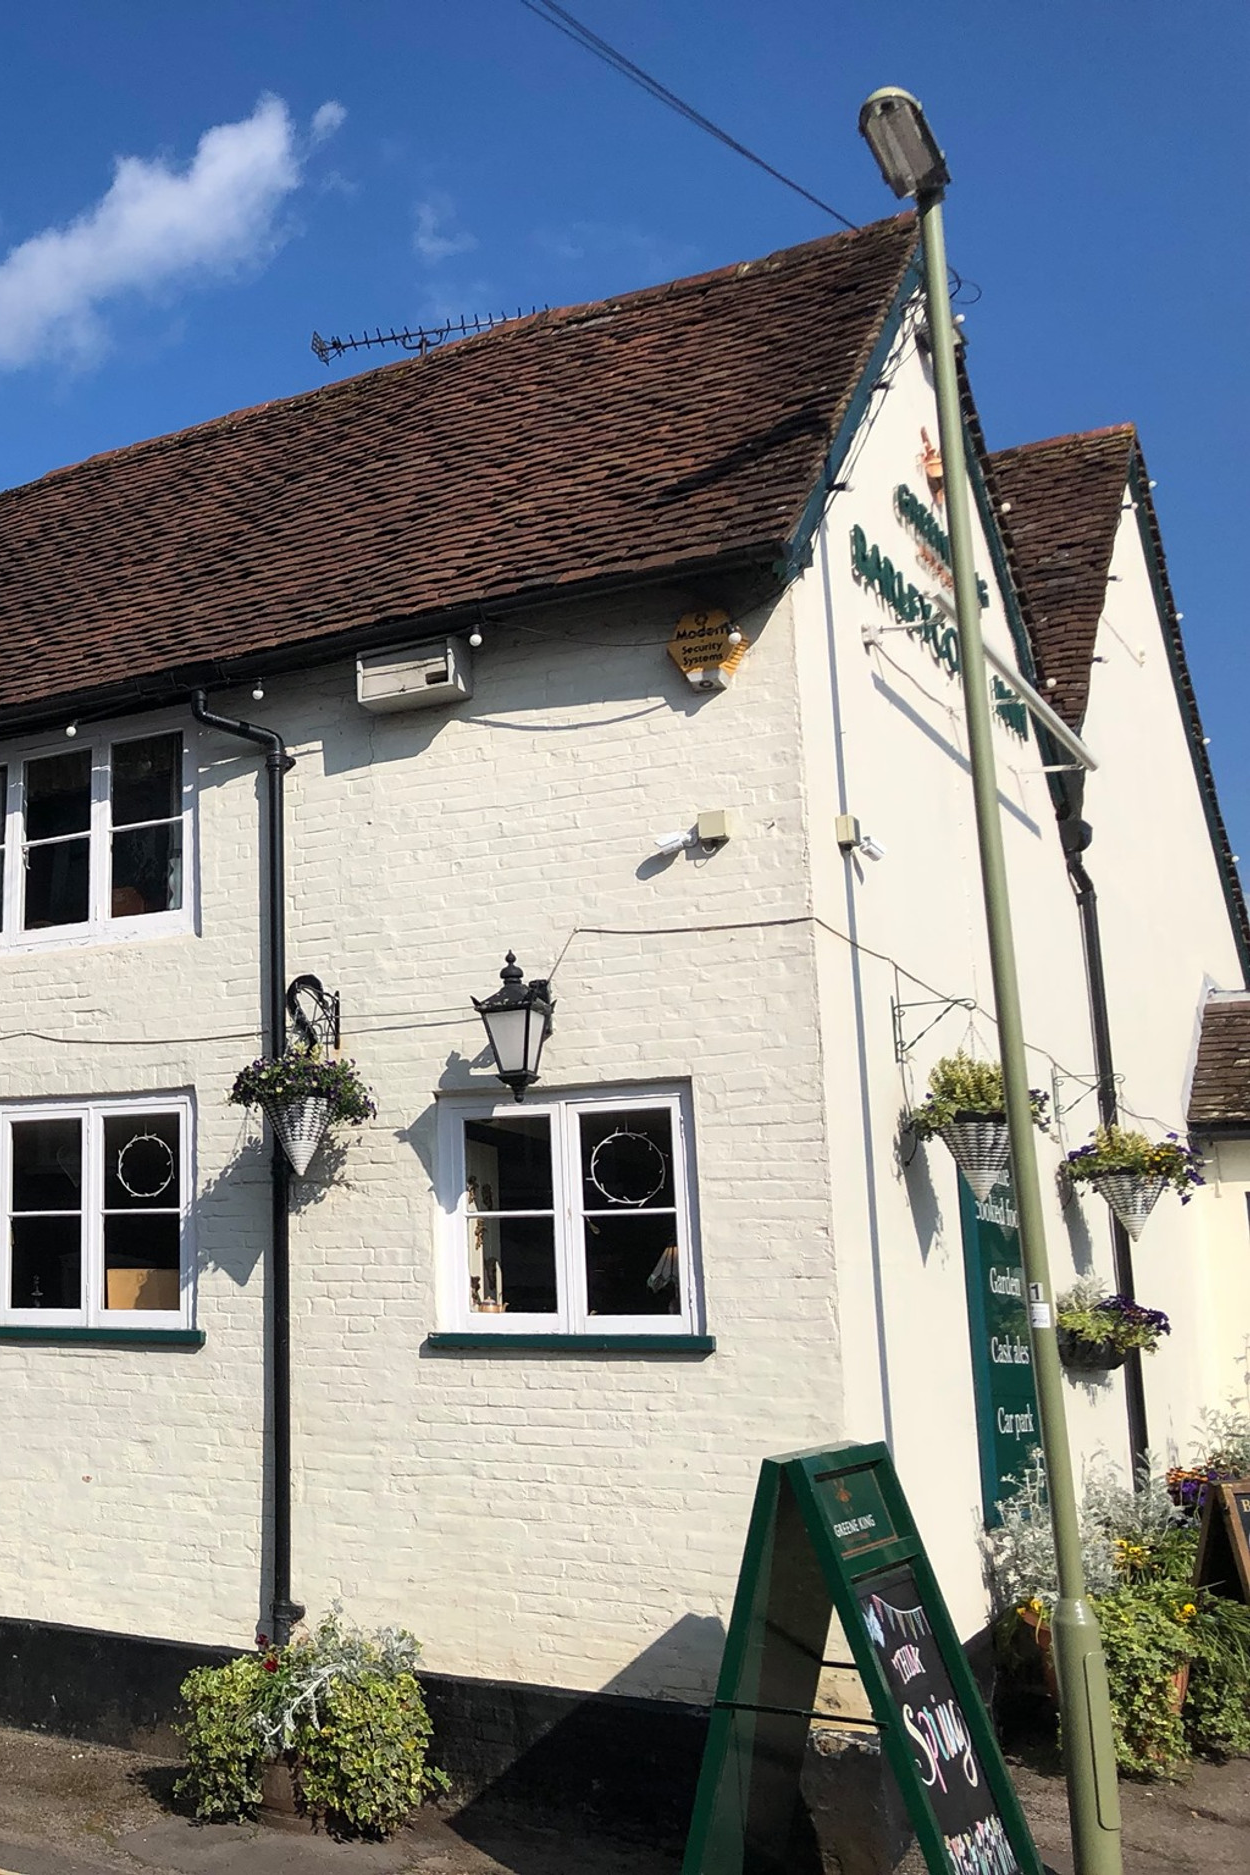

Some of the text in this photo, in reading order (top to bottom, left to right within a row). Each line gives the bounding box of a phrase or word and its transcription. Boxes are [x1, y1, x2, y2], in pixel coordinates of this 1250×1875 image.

[682, 642, 723, 655] Security
[683, 653, 723, 667] Systems
[989, 1266, 1022, 1297] Garden
[991, 1334, 1030, 1365] Cask ales
[997, 1403, 1035, 1441] Car park
[833, 1518, 860, 1538] GREENE
[857, 1513, 876, 1530] KING
[903, 1694, 978, 1794] Spring
